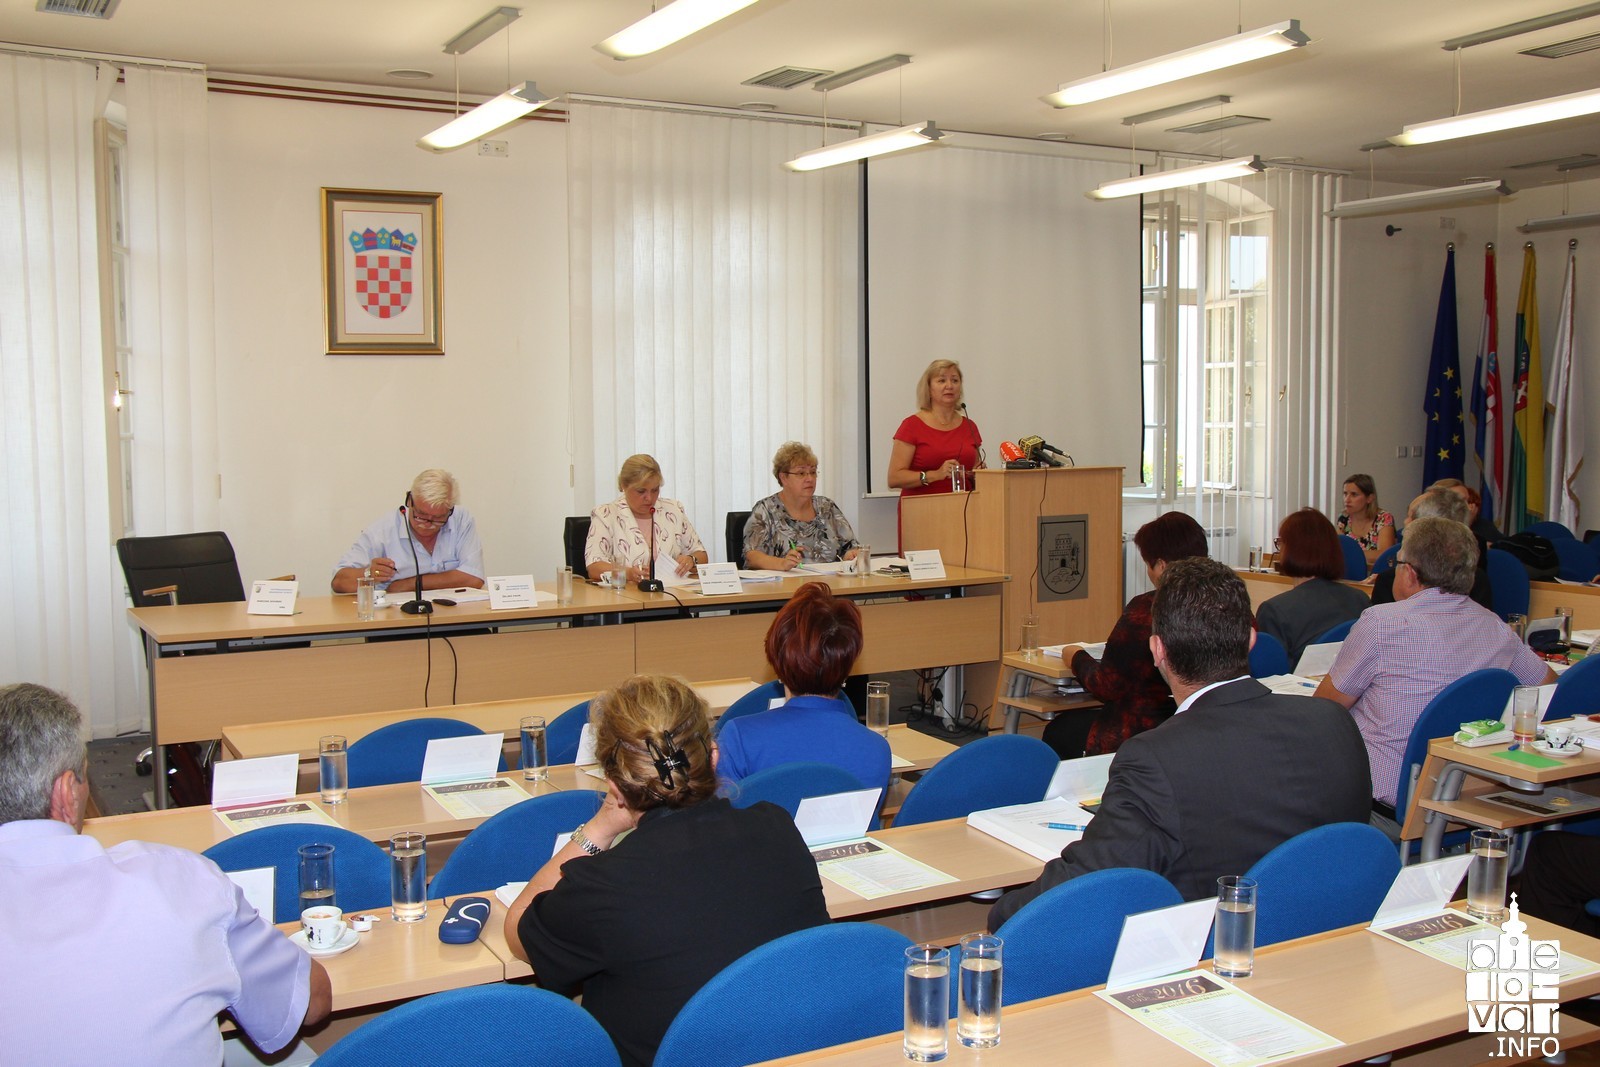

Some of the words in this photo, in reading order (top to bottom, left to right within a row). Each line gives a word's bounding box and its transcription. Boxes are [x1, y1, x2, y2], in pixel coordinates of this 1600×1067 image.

[830, 843, 870, 857] 2016
[1416, 916, 1464, 933] 2016
[1151, 979, 1207, 999] 2016
